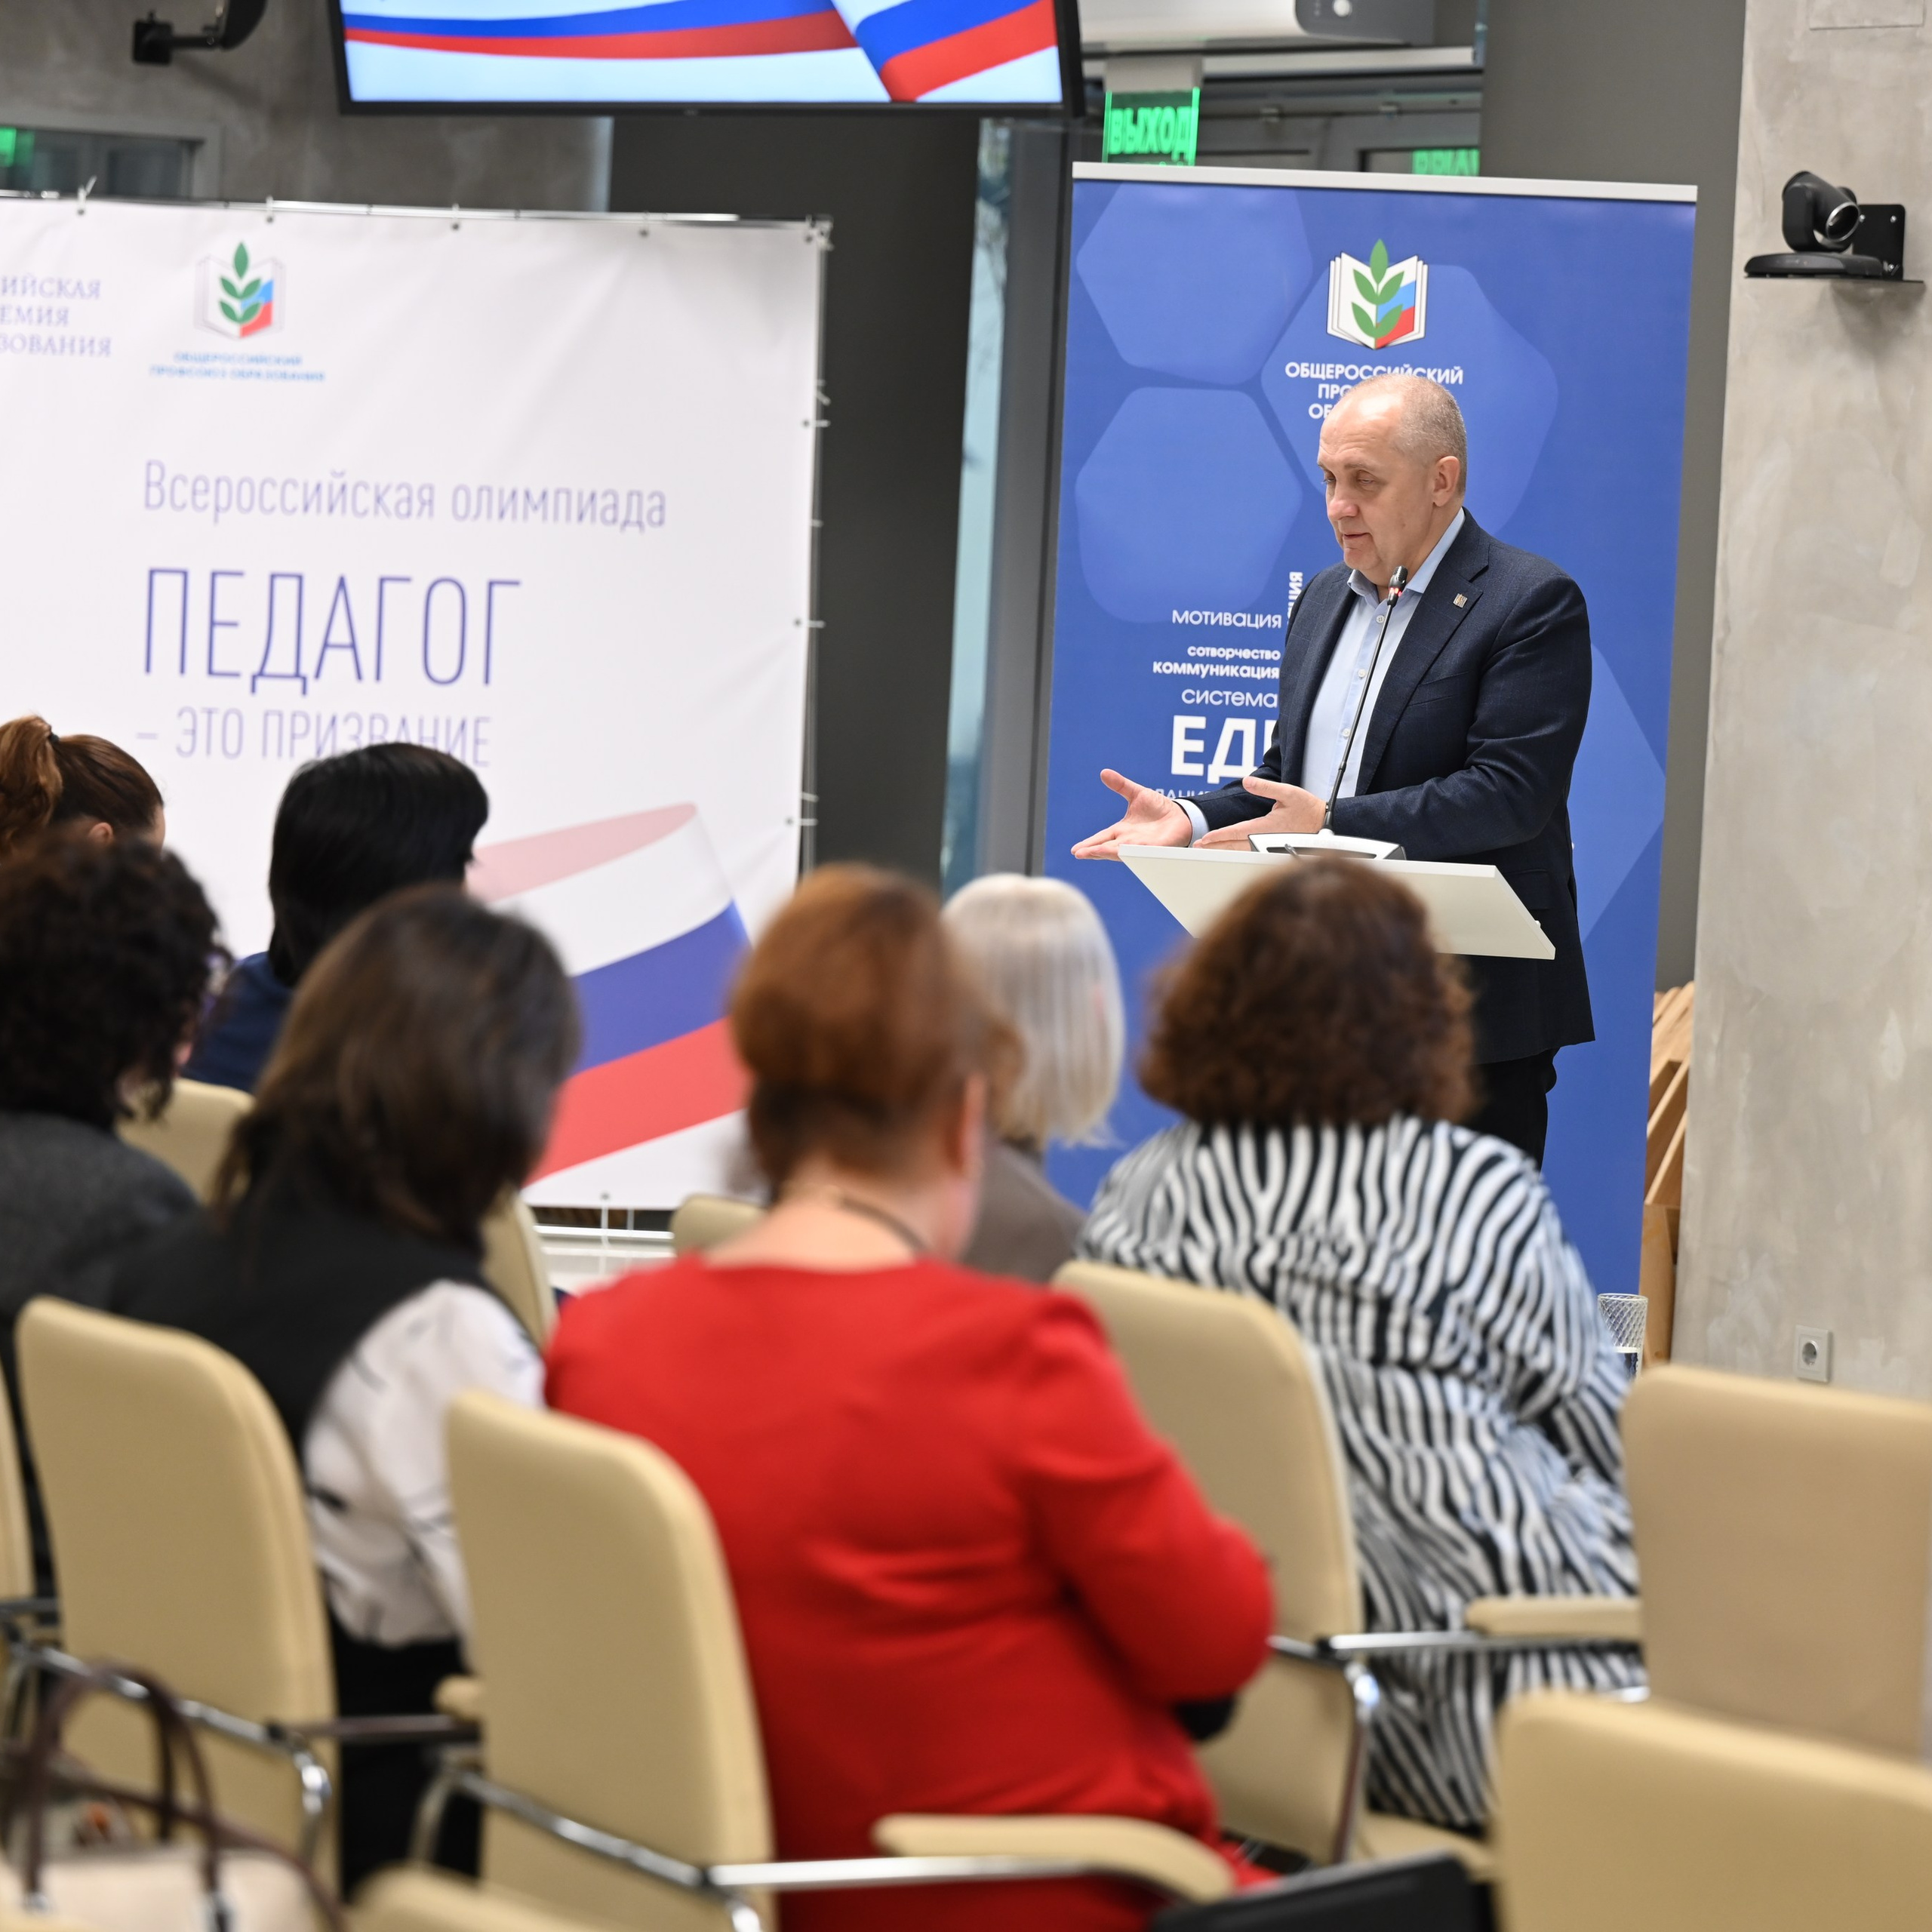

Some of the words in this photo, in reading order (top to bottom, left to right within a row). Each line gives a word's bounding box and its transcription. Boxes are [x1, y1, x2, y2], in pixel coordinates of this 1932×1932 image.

[1109, 106, 1194, 162] ВЫХОД
[1, 272, 101, 300] ИЙСКАЯ
[0, 304, 69, 327] ЕМИЯ
[1284, 361, 1464, 385] ОБЩЕРОССИЙСКИЙ
[143, 459, 436, 526] Всероссийская
[451, 483, 666, 534] олимпиада
[144, 568, 521, 696] ПЕДАГОГ
[1187, 646, 1281, 660] сотворчество
[1152, 661, 1280, 679] коммуникация
[1181, 689, 1278, 708] система
[175, 706, 245, 759] ЭТО
[262, 708, 491, 768] ПРИЗВАНИЕ
